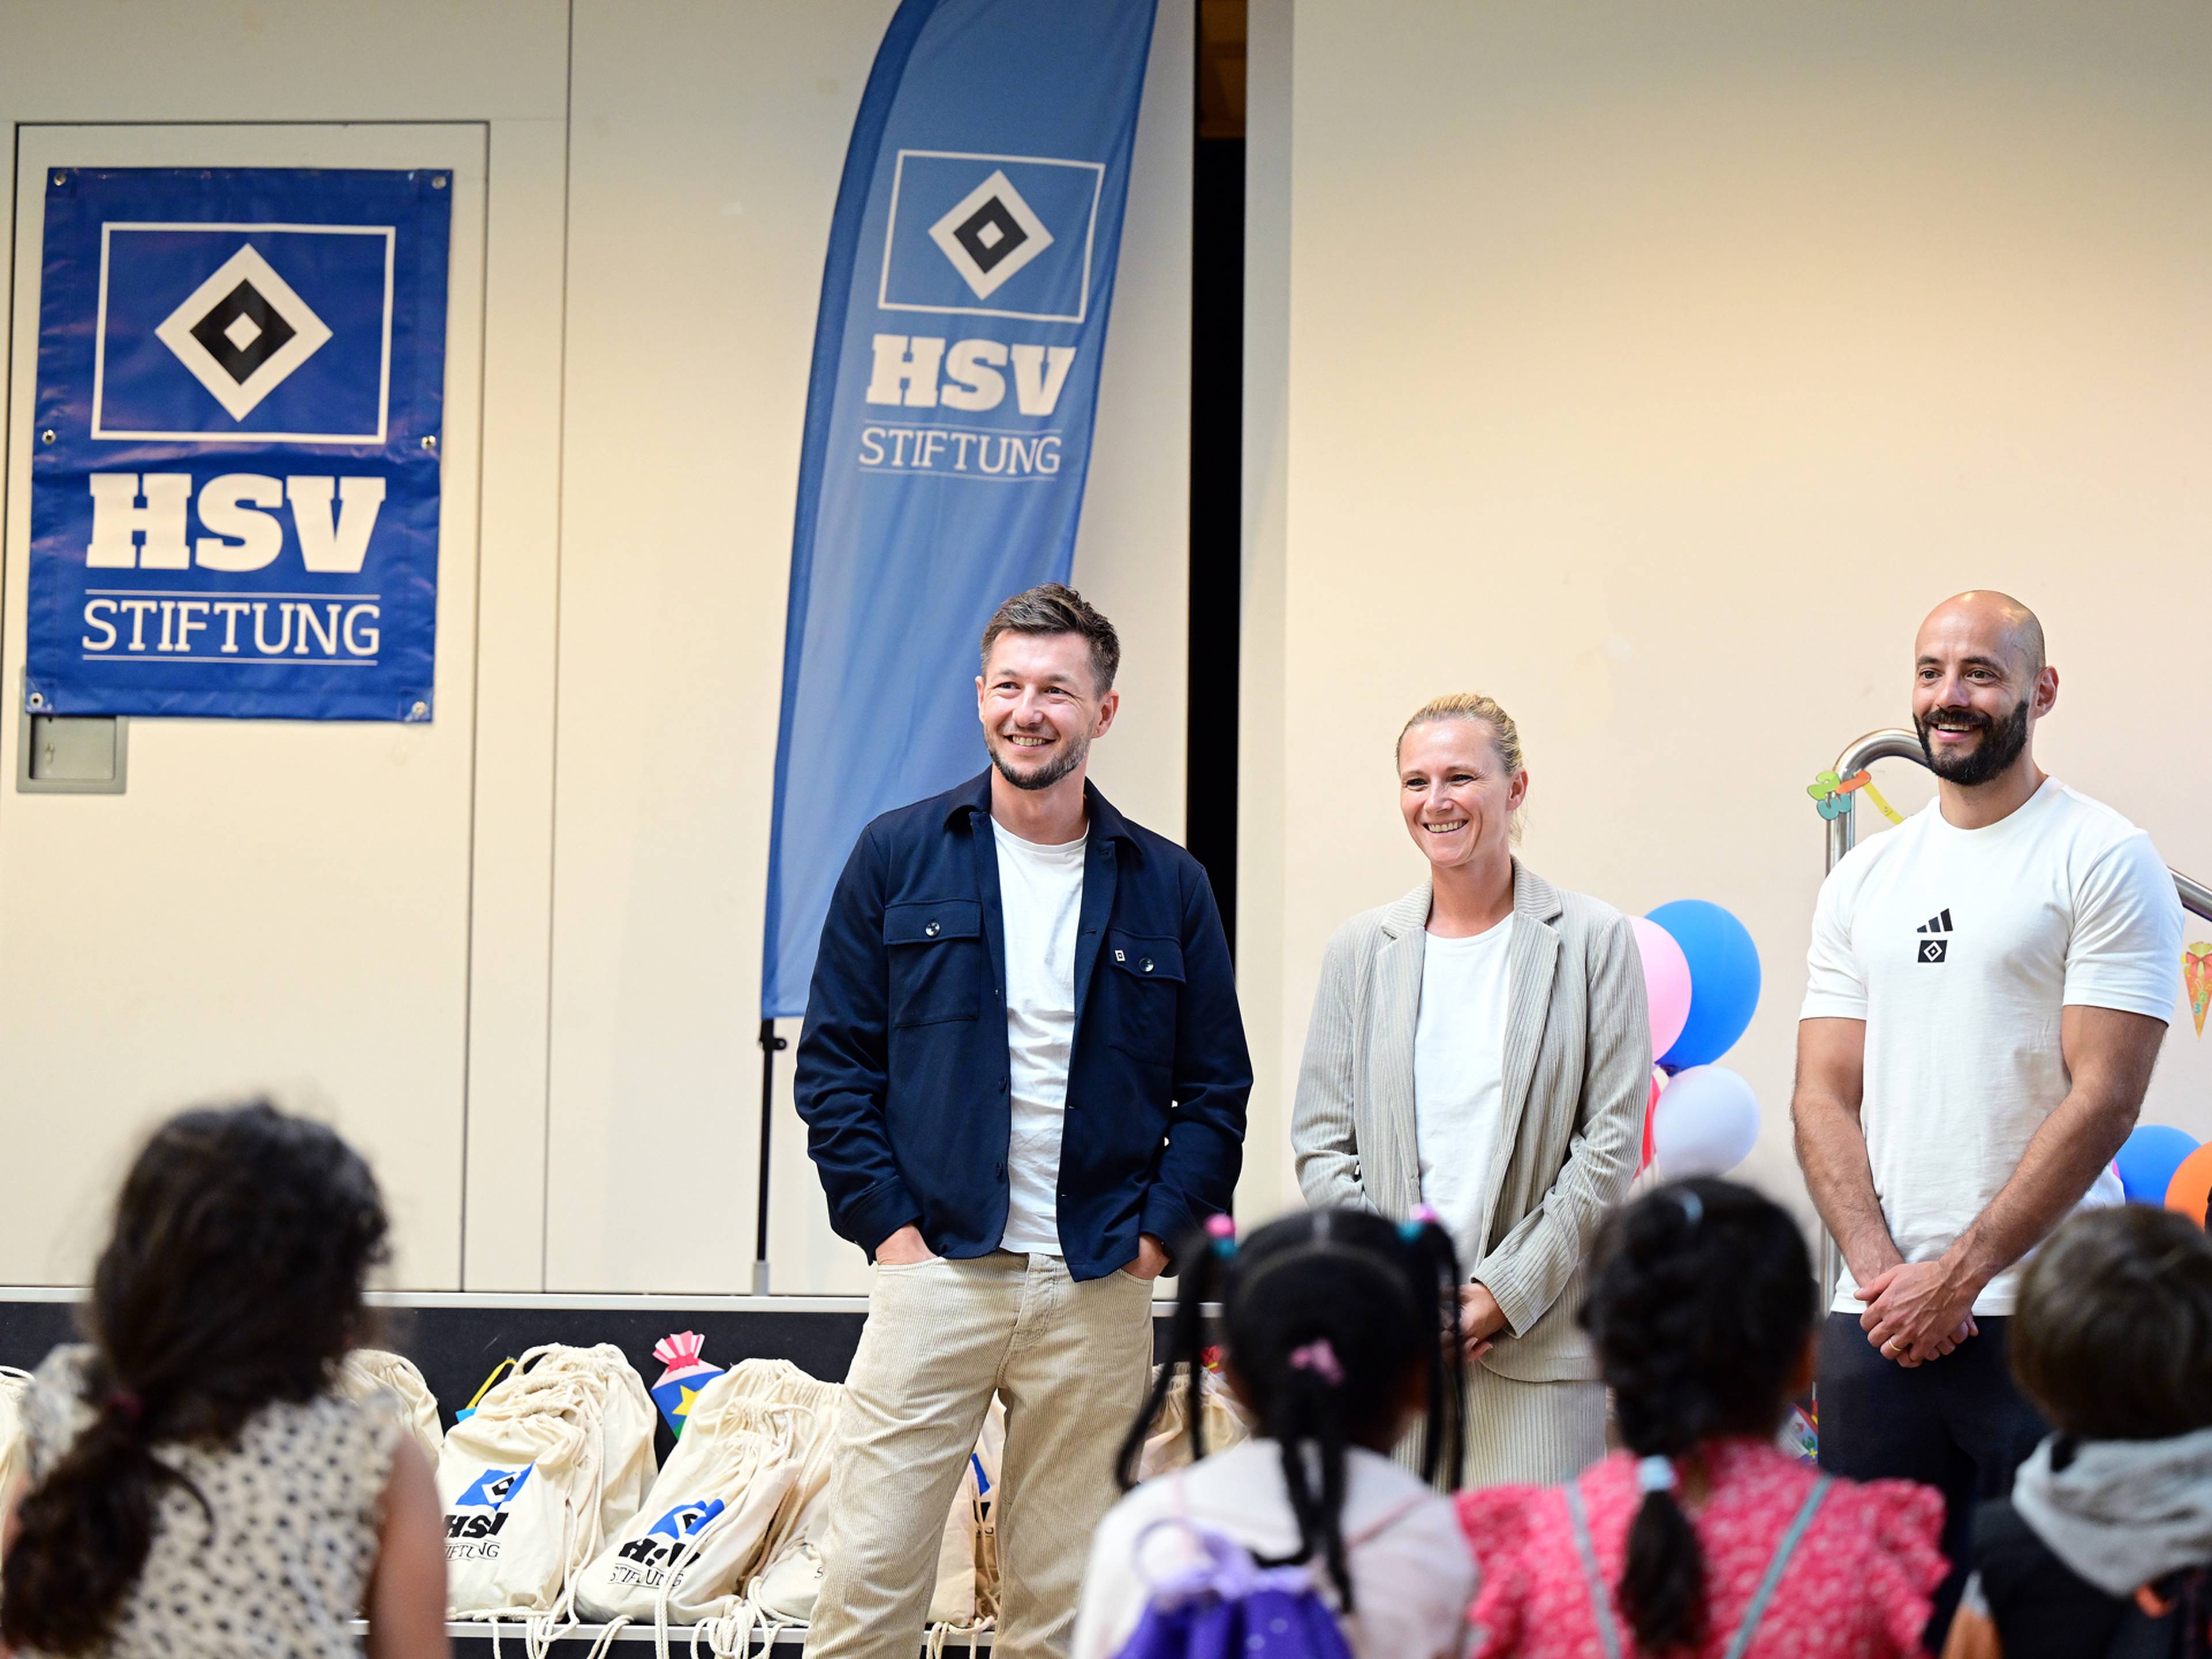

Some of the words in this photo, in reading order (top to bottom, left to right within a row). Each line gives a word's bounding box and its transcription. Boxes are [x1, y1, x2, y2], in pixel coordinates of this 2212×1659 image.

[866, 334, 1077, 416] HSV
[858, 427, 1062, 475] STIFTUNG
[86, 473, 386, 573] HSV
[82, 599, 380, 656] STIFTUNG
